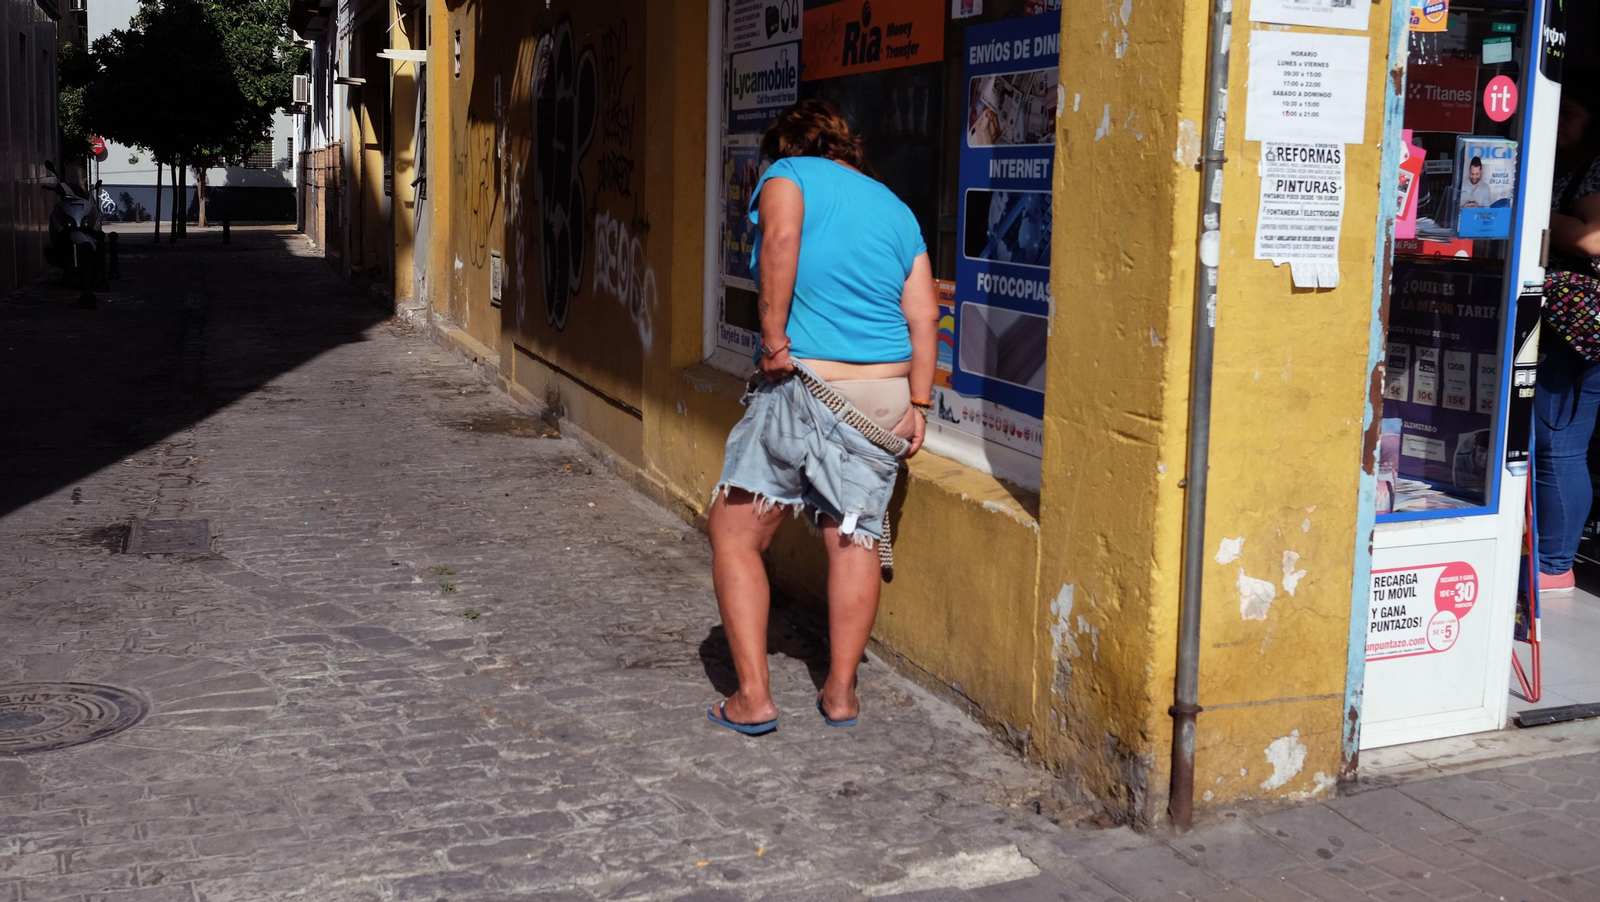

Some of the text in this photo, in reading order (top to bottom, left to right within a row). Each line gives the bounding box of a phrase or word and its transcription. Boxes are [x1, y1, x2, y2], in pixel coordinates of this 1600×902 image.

[842, 2, 881, 67] Ria
[886, 22, 913, 38] Money
[886, 40, 919, 60] Transfer
[969, 38, 1010, 65] ENVÍOS
[1014, 39, 1030, 60] DE
[734, 59, 796, 101] Lycamobile
[1424, 85, 1472, 101] Titanes
[1277, 146, 1341, 164] REFORMAS
[1469, 146, 1512, 159] DIGI
[989, 158, 1050, 178] INTERNET
[1276, 180, 1337, 194] PINTURAS
[1403, 240, 1418, 249] País
[720, 324, 739, 344] Tarjeta
[741, 335, 750, 347] SIM
[1447, 363, 1465, 371] 12GB
[1418, 391, 1432, 400] 10€
[1448, 396, 1464, 405] 15€
[1404, 421, 1437, 433] ILIMITADO
[1374, 573, 1418, 588] RECARGA
[1373, 590, 1385, 601] TU
[1372, 605, 1406, 619] Y GANA
[1371, 617, 1422, 633] PUNTAZOS!
